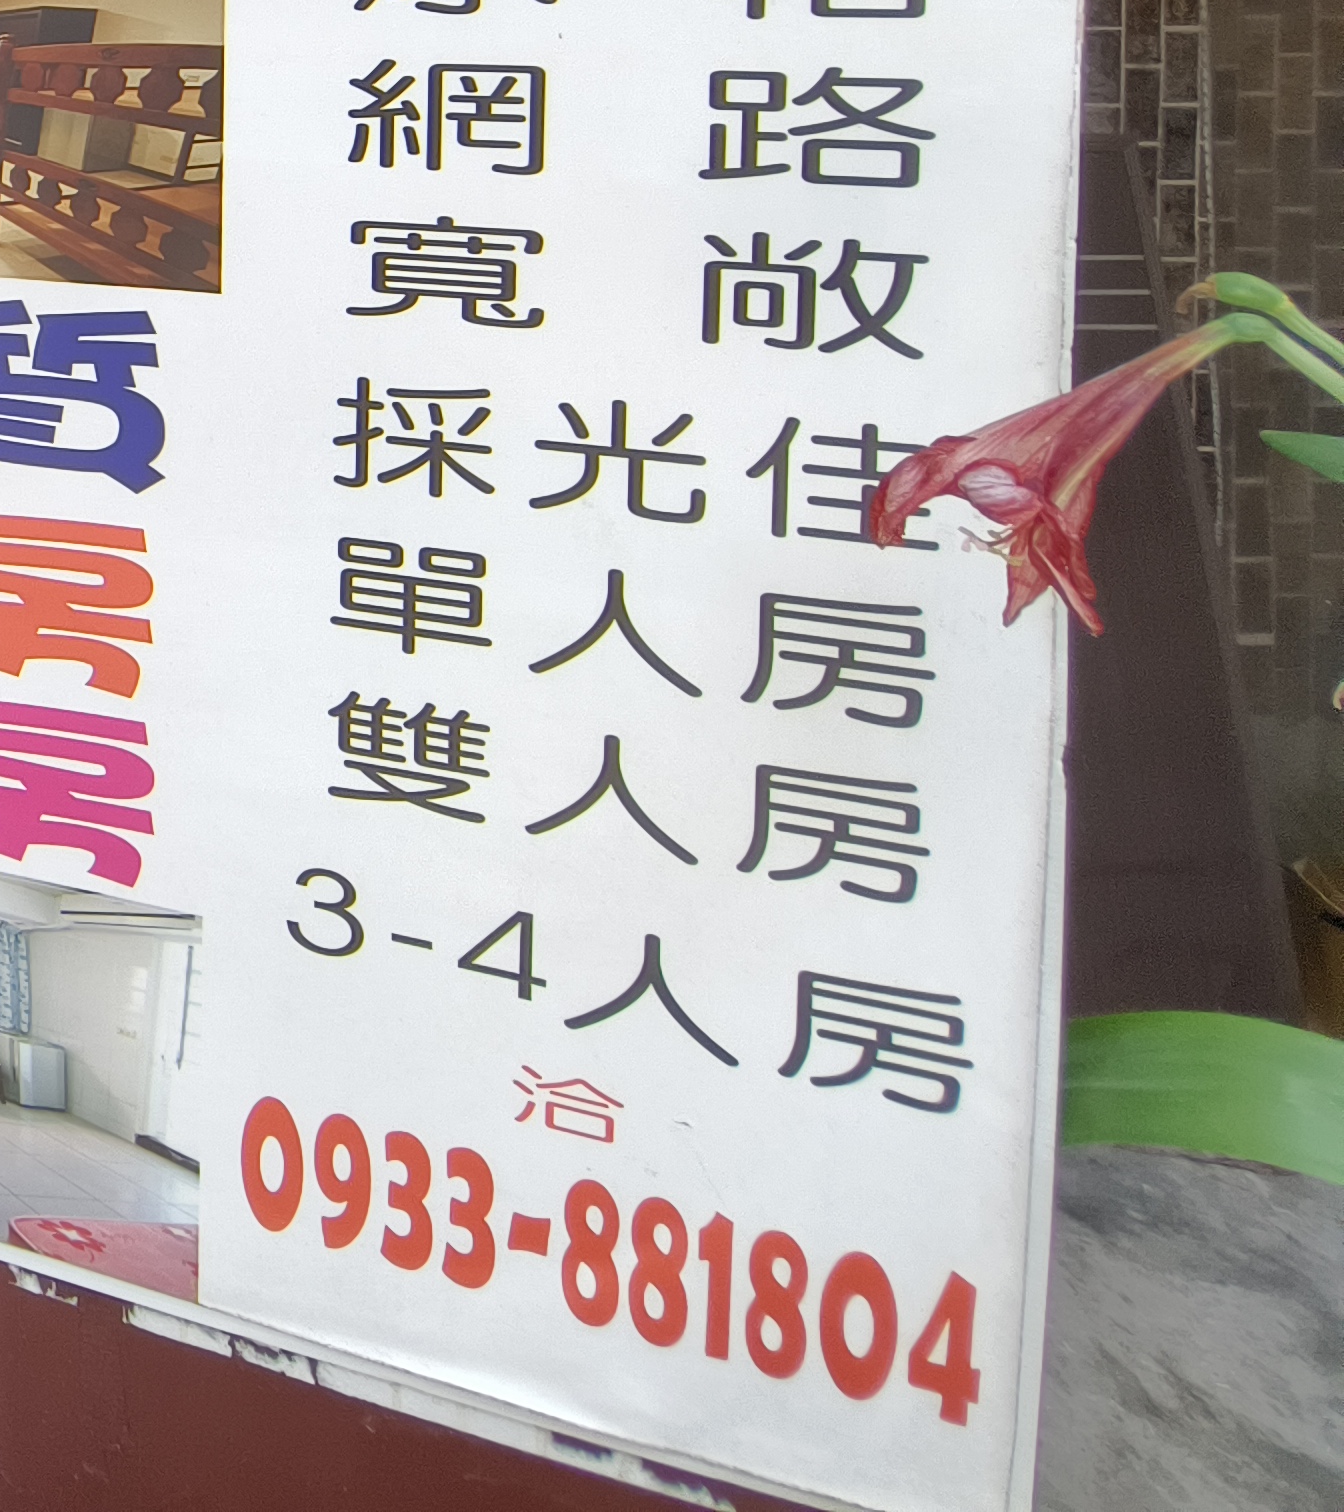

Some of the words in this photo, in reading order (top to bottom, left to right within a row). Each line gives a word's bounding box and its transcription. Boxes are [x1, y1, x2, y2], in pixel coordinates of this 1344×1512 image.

[346, 58, 937, 189] 網路
[345, 215, 931, 361] 寬敞
[331, 376, 940, 551] 採光佳
[329, 536, 937, 730] 單人房
[327, 690, 931, 904] 雙人房
[512, 1063, 625, 1144] 洽
[240, 1094, 982, 1428] 0933-881804
